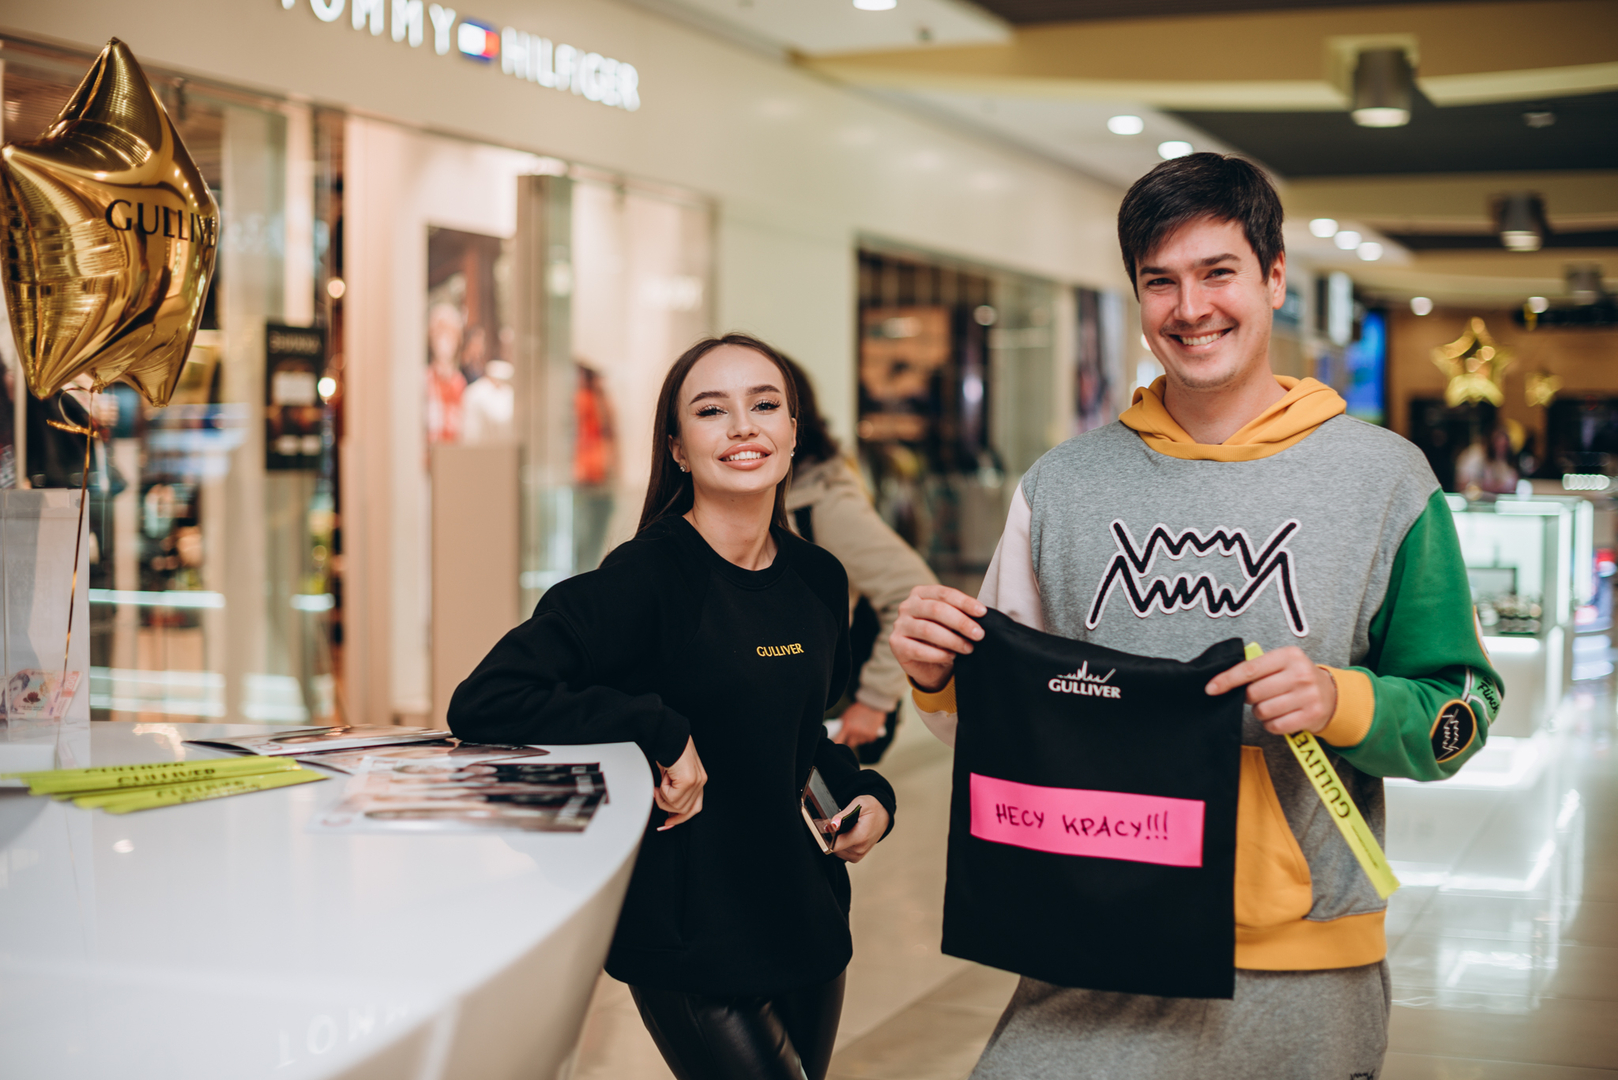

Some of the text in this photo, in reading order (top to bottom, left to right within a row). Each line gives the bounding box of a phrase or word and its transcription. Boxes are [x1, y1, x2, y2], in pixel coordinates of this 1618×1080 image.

[281, 0, 641, 112] MMY HILFIGER
[756, 643, 805, 657] GULLIVER
[1048, 678, 1122, 699] GULLIVER
[1477, 681, 1500, 714] Flinch
[995, 803, 1168, 841] НЕСУ КРАСУ!!!
